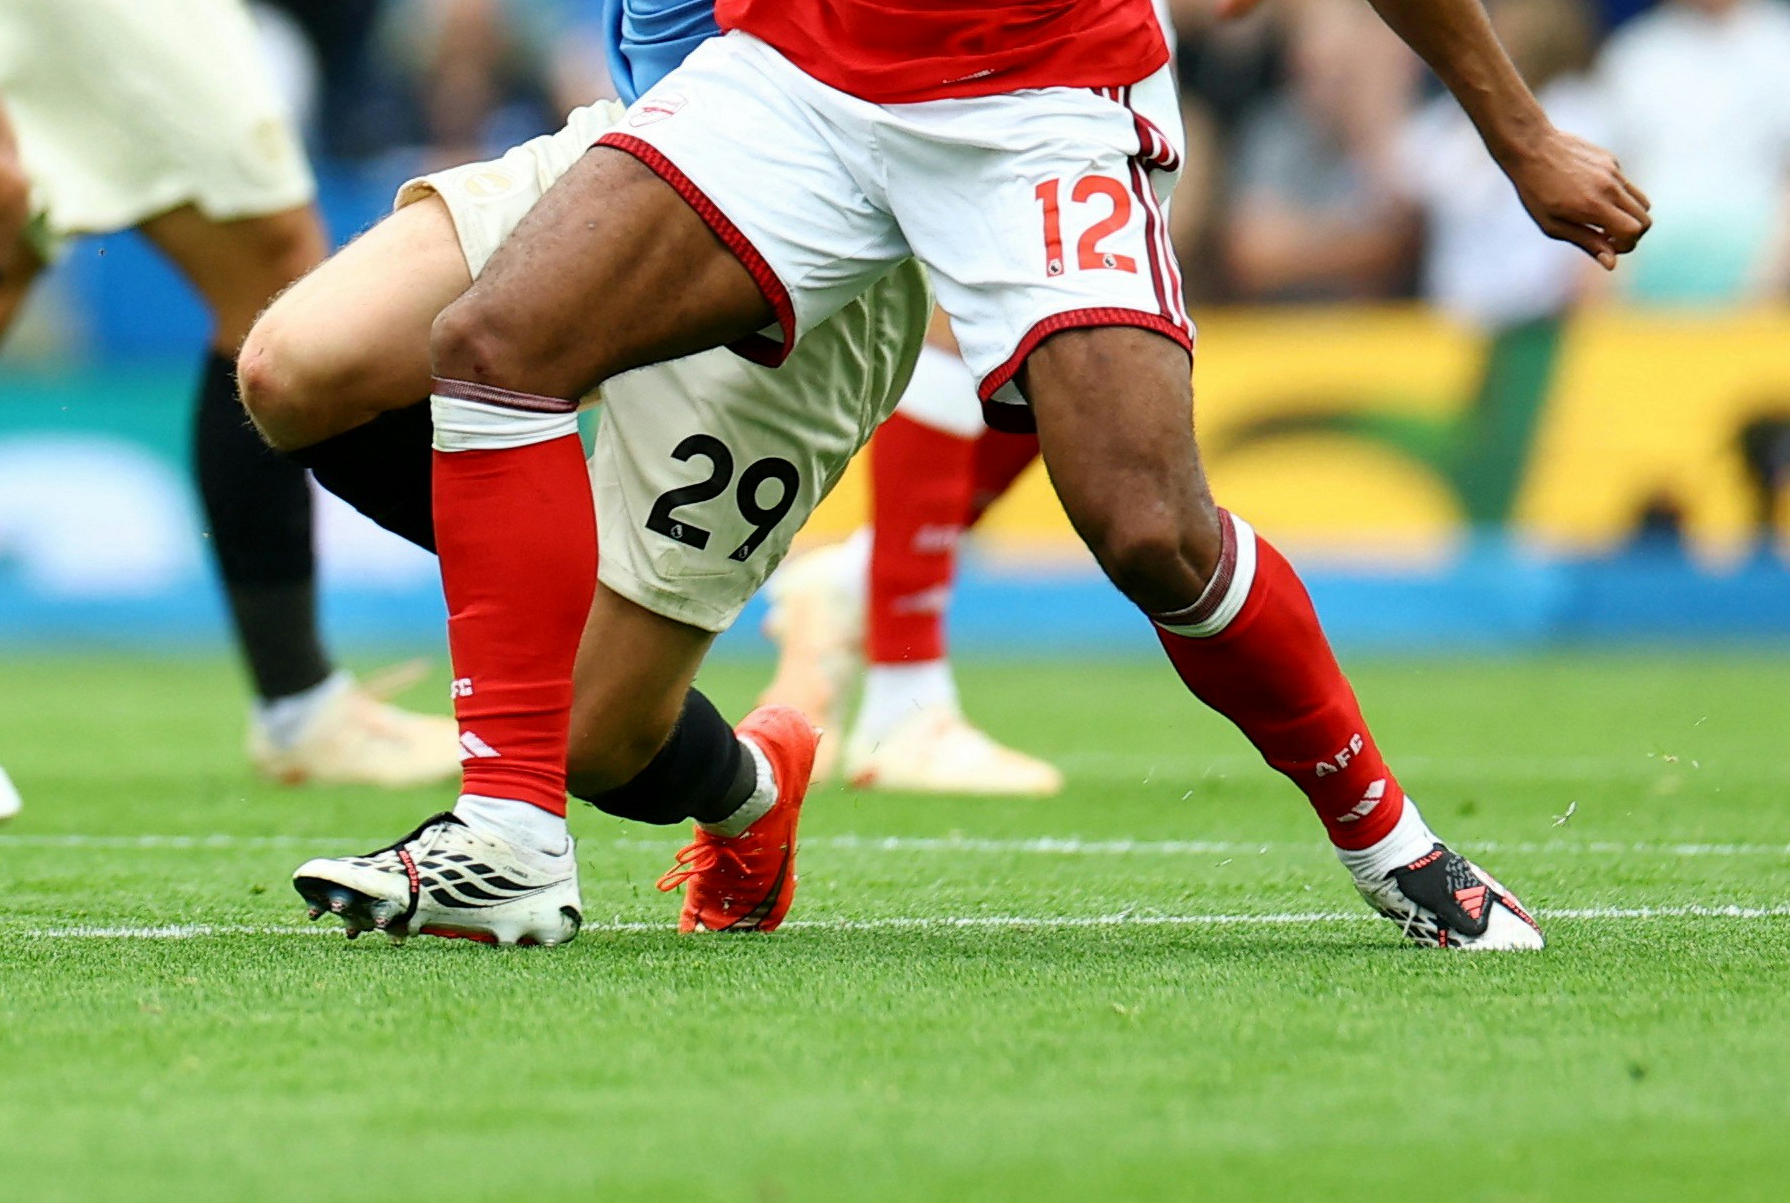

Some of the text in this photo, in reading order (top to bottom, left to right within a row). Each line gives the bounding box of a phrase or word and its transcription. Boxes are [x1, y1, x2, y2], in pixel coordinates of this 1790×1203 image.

[1035, 174, 1138, 278] 12
[645, 434, 800, 563] 29
[450, 677, 474, 700] FC
[1315, 732, 1364, 777] AFC
